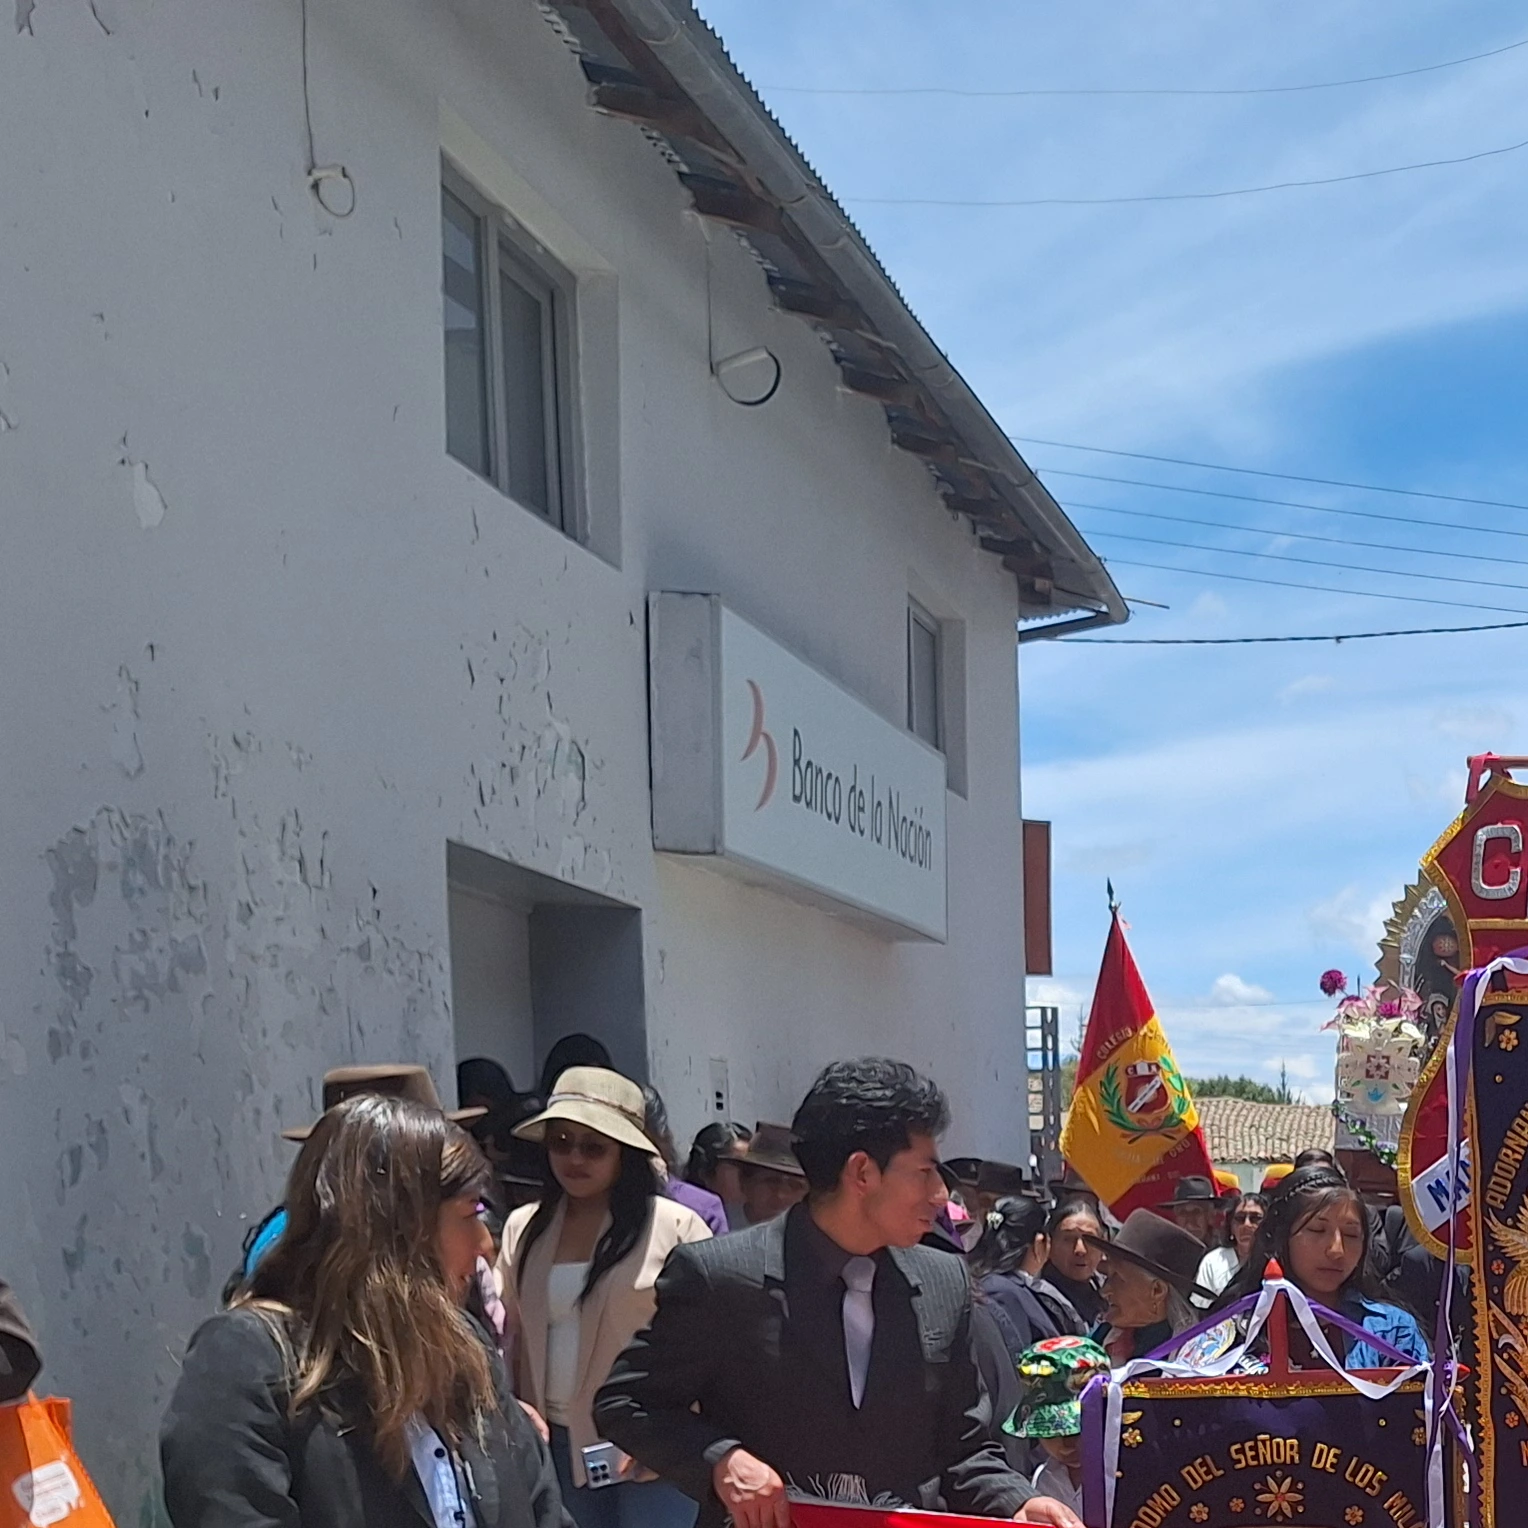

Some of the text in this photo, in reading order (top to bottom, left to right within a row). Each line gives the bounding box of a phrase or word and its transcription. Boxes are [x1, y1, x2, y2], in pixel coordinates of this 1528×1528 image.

[791, 726, 932, 871] Banco de la Nación
[1470, 823, 1523, 899] C
[1096, 1026, 1133, 1060] COLEGIO
[1180, 1454, 1225, 1491] DEL
[1230, 1434, 1300, 1470] SEÑOR
[1311, 1443, 1341, 1474] DE
[1344, 1456, 1389, 1497] LOS
